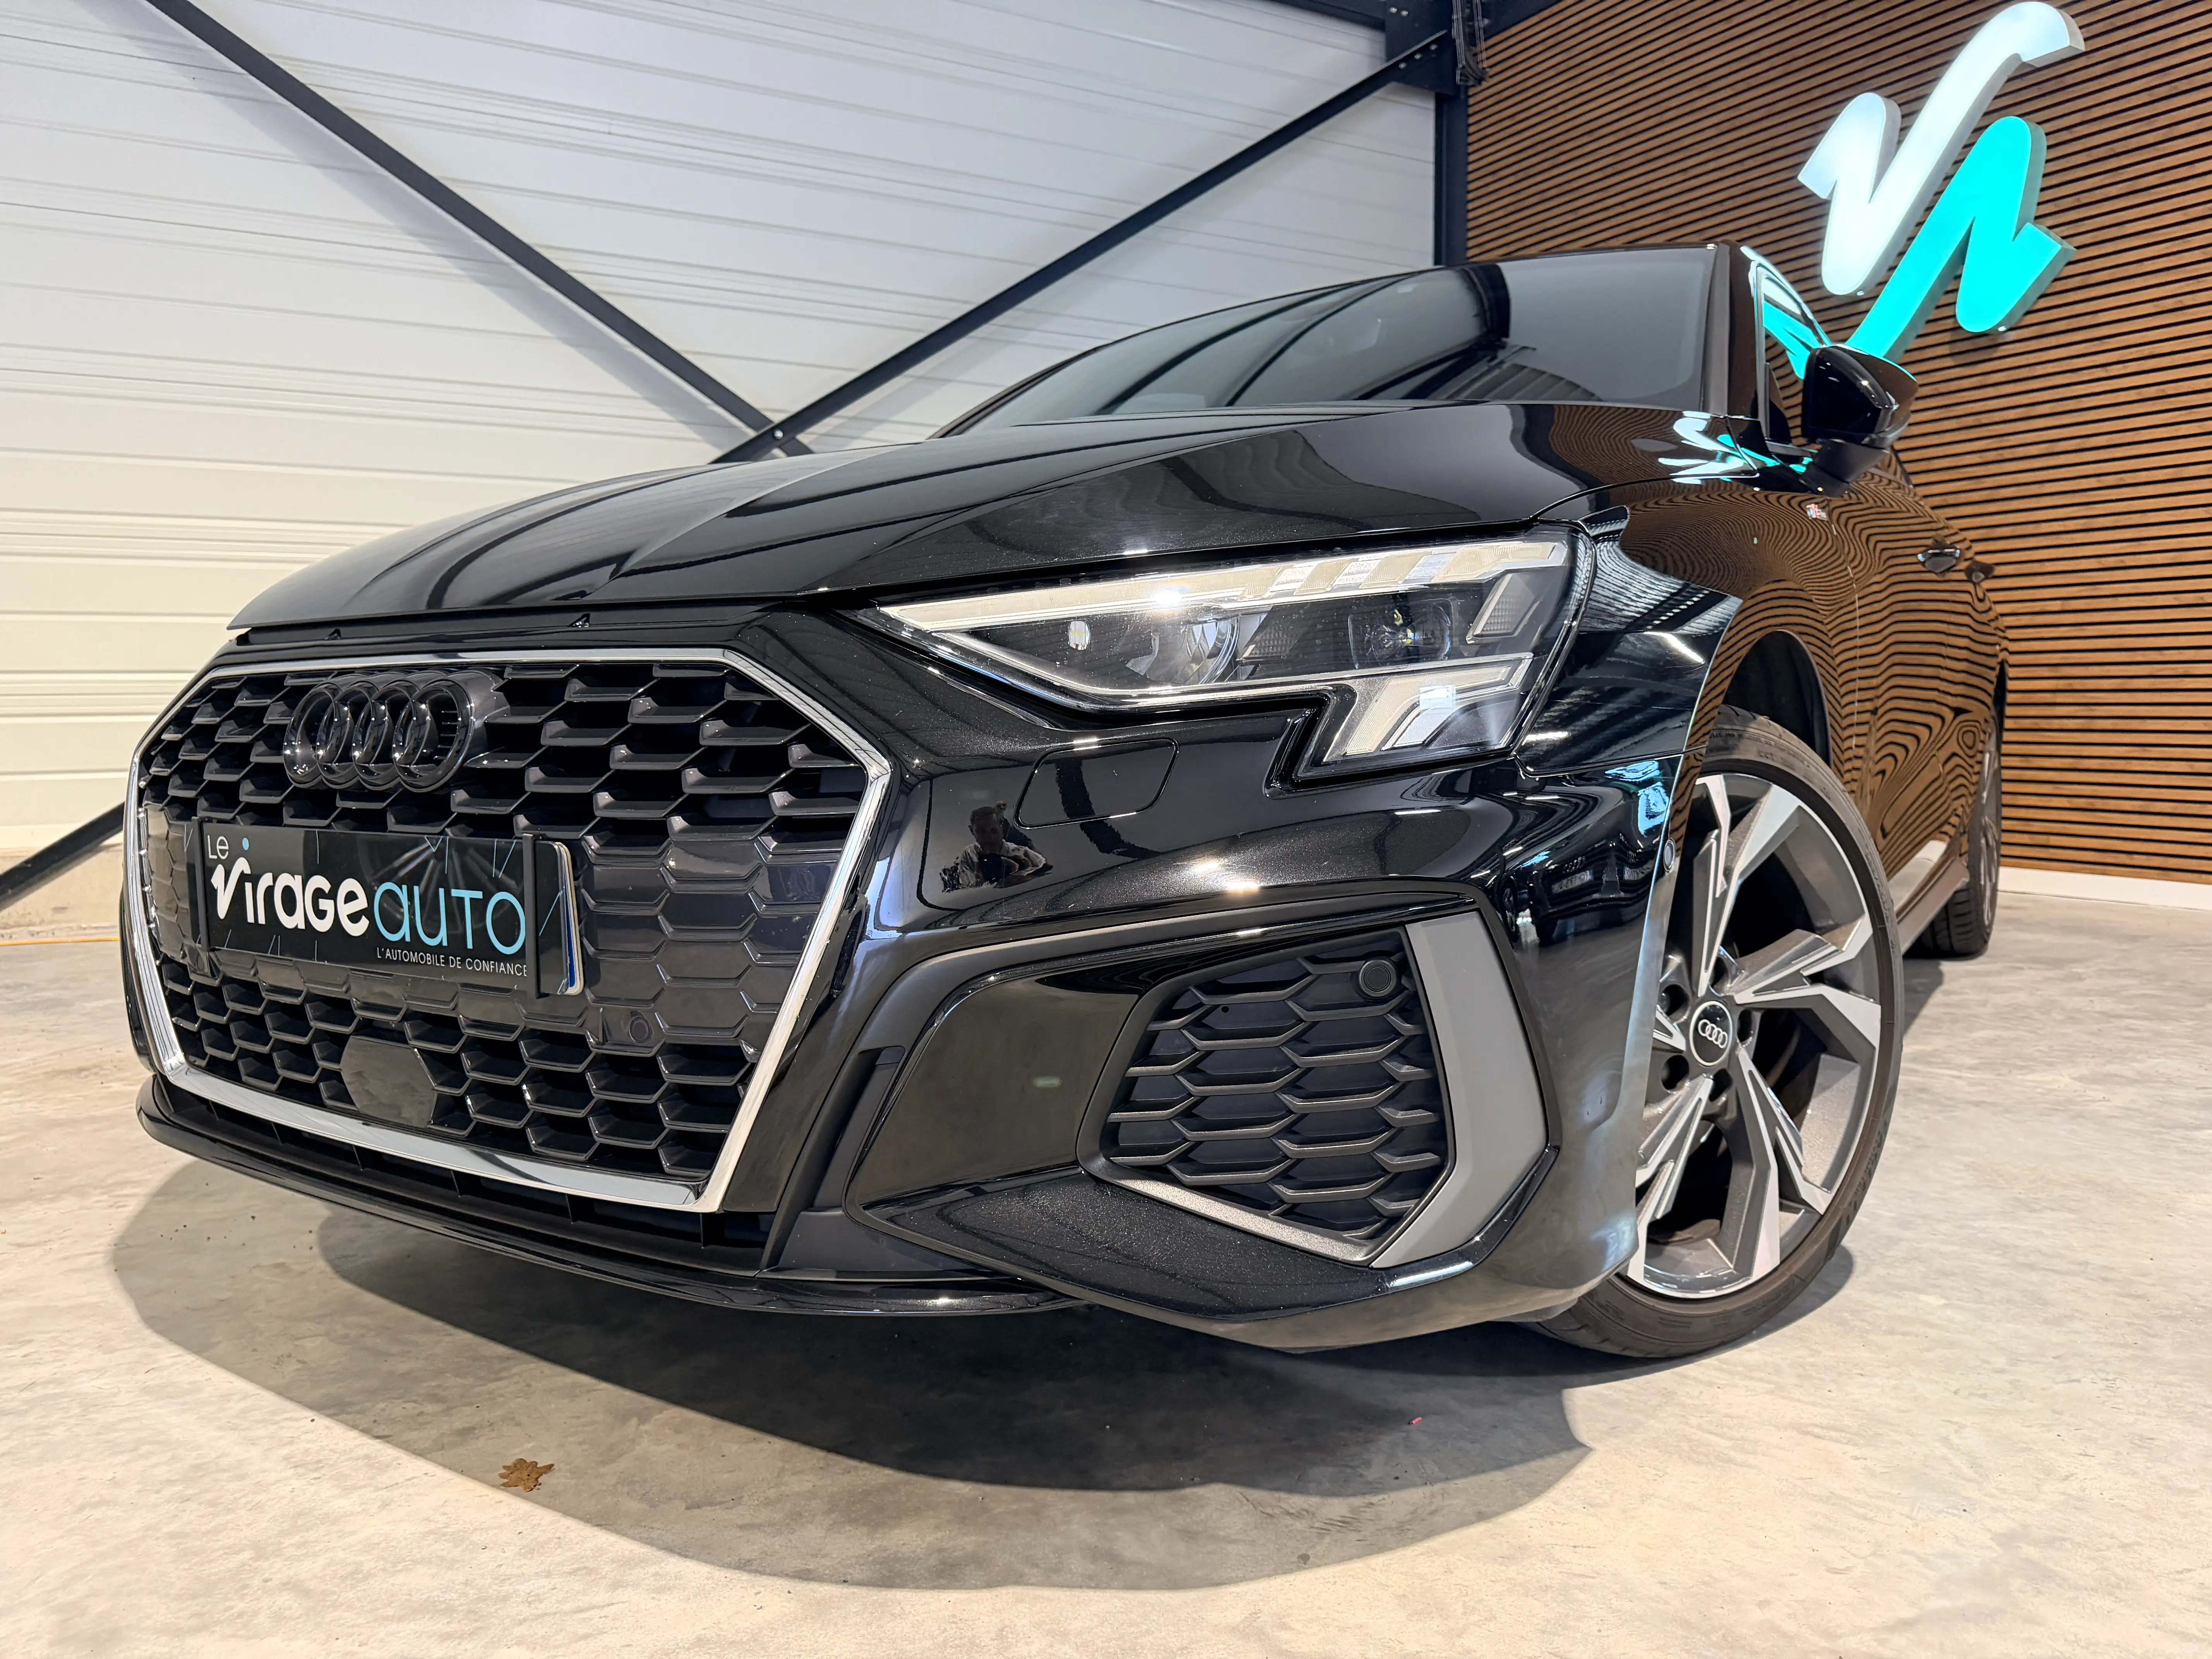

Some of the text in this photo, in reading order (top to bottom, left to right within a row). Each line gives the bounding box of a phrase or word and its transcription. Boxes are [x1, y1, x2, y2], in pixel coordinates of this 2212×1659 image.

[377, 947, 527, 977] L'AUTOMOBILE DE CONFIANCE
